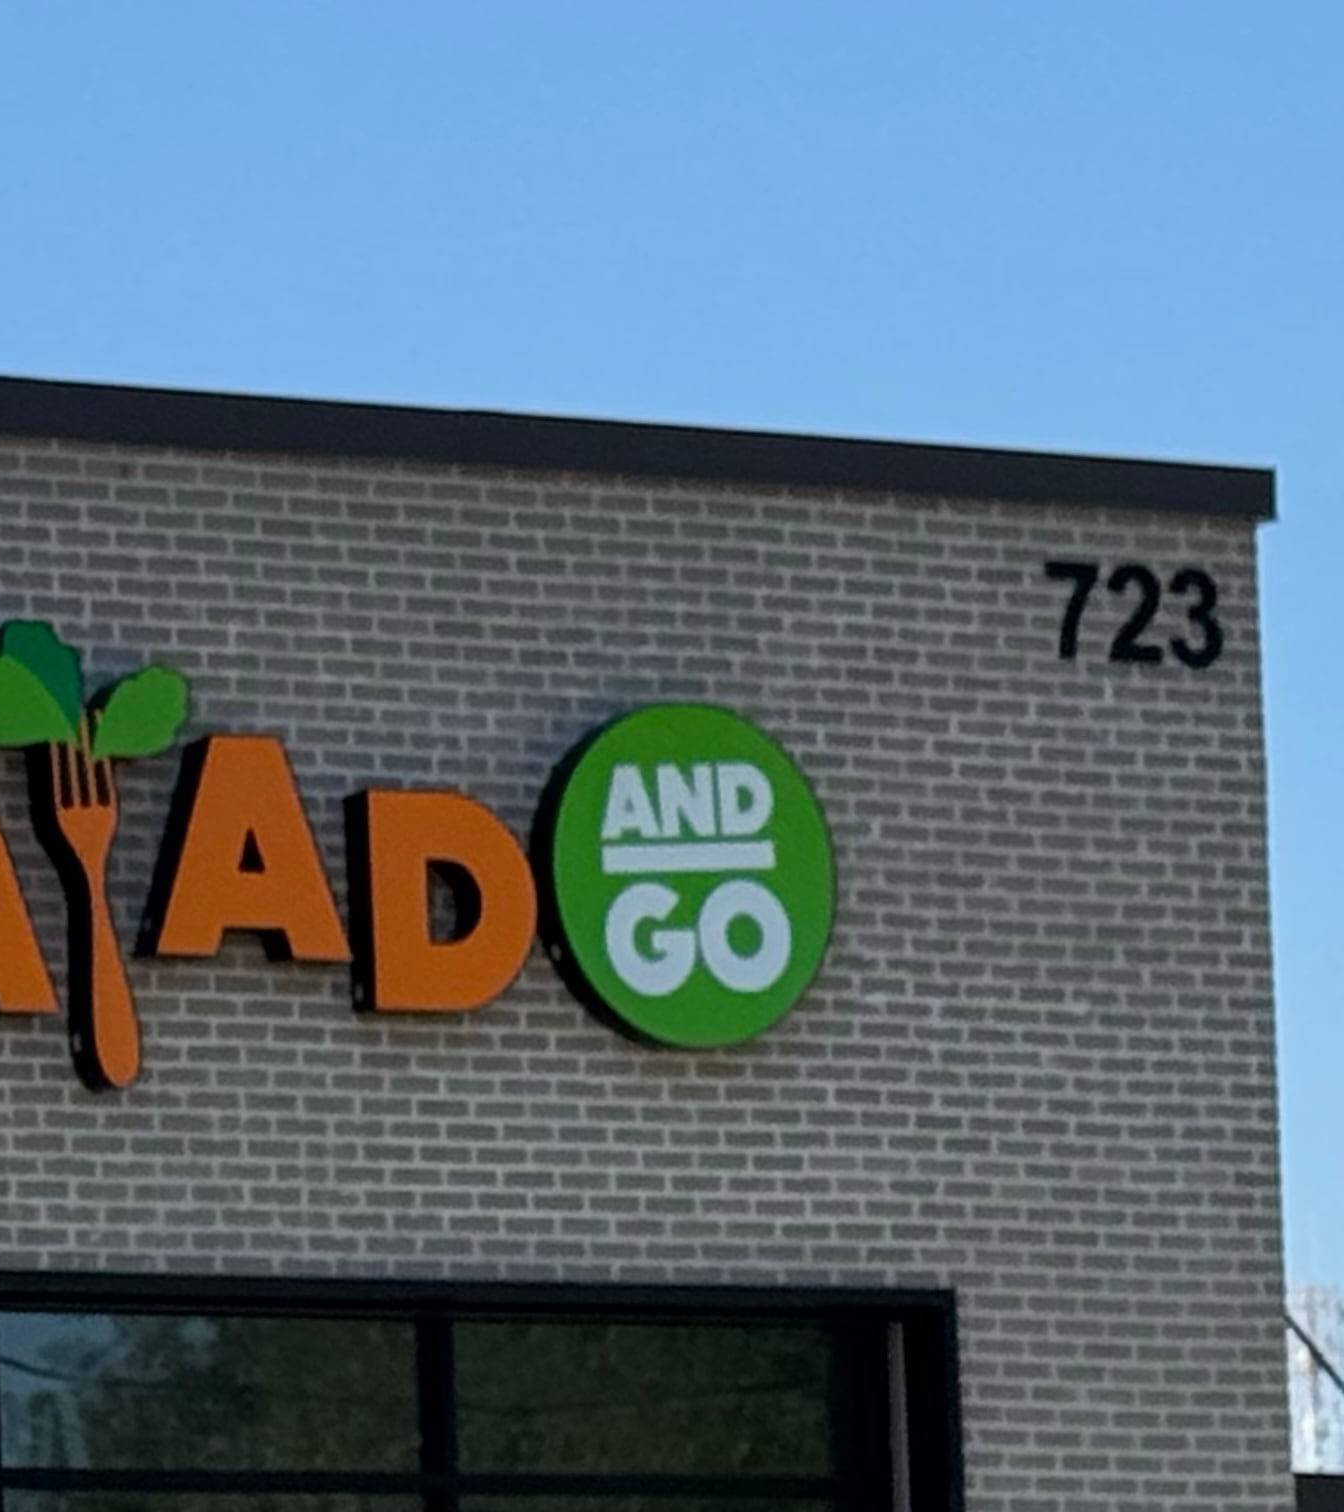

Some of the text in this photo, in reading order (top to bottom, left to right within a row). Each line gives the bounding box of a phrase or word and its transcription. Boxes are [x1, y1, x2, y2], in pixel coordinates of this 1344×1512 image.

[1043, 560, 1224, 670] 723
[600, 763, 774, 840] AND
[604, 879, 791, 996] GO
